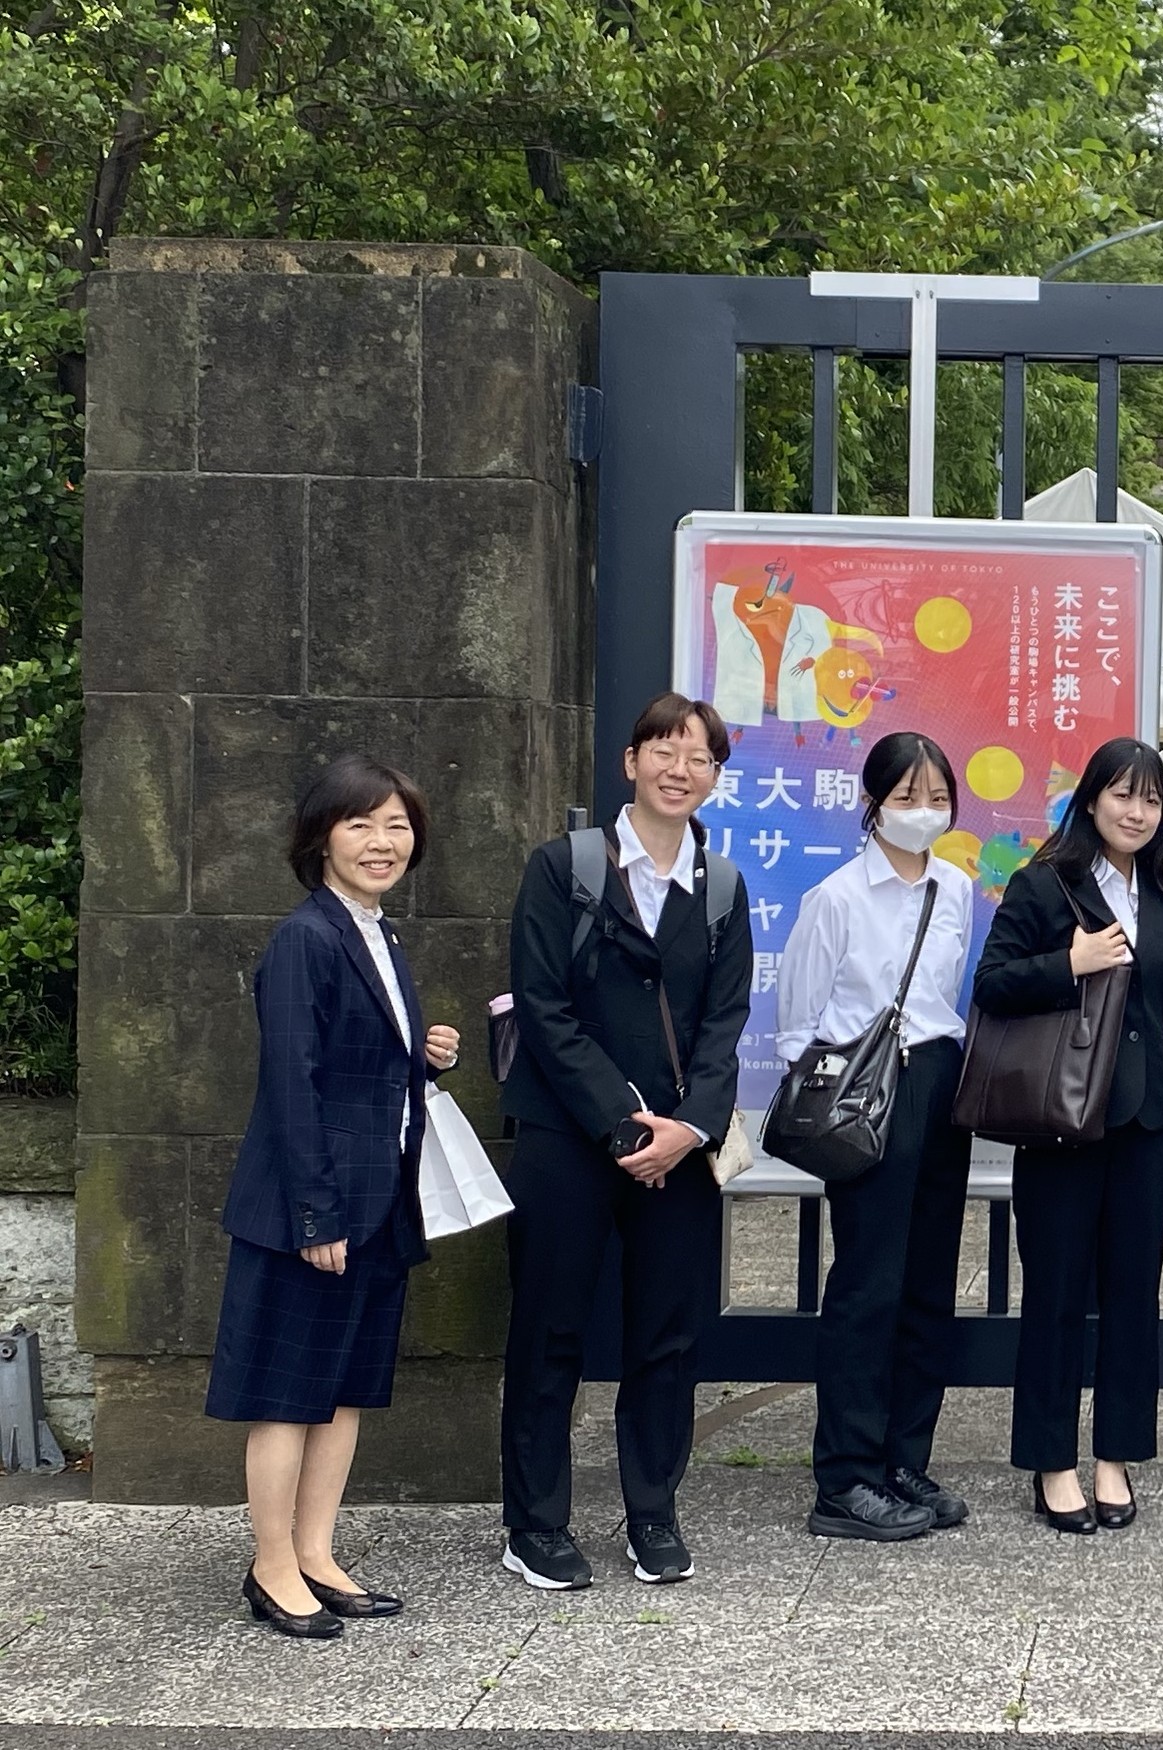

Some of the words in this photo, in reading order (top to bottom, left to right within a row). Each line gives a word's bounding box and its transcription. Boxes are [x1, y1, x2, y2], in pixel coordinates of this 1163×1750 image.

[833, 560, 854, 570] THE
[861, 561, 935, 572] UNIVERSITY
[941, 564, 957, 573] OF
[963, 565, 1004, 574] TOKYO
[1052, 582, 1083, 731] 未来に挑む
[1096, 586, 1122, 686] ここで、
[705, 828, 868, 870] リサー
